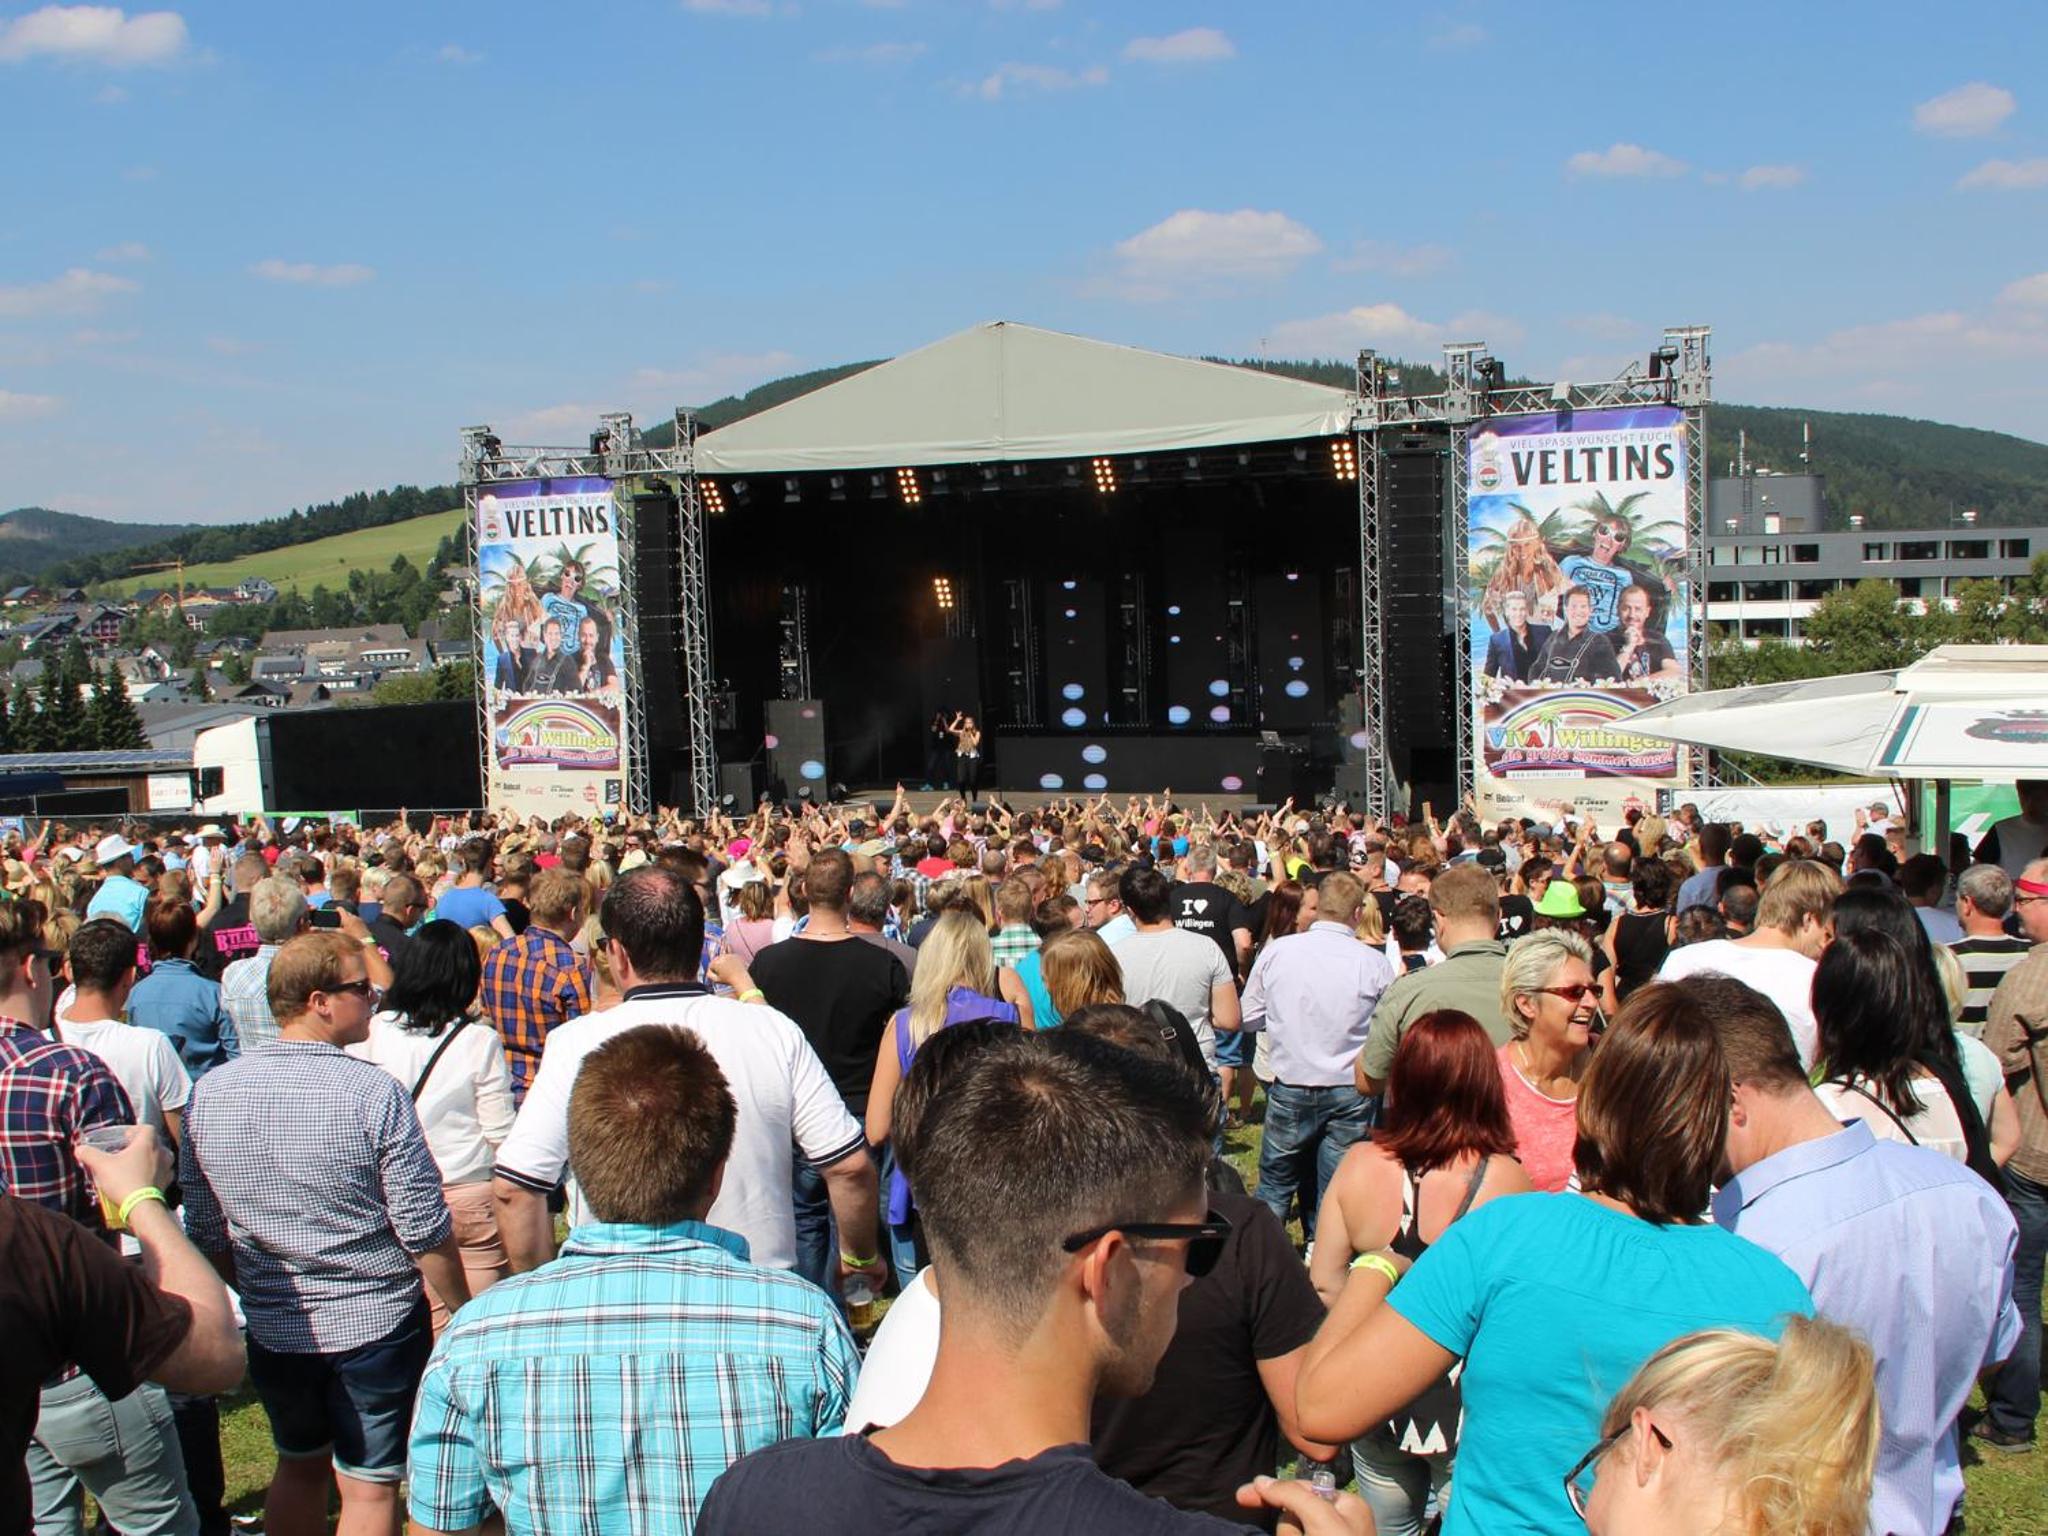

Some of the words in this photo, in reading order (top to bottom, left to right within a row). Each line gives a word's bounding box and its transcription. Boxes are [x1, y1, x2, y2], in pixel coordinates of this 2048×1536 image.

[1510, 438, 1534, 449] VIEL
[1538, 436, 1573, 448] SPASS
[1639, 431, 1672, 442] EUCH
[1510, 443, 1674, 486] VELTINS
[505, 505, 609, 538] VELTINS
[542, 731, 614, 751] Willingen
[1487, 727, 1543, 748] VIVA
[1182, 899, 1193, 915] I
[1175, 919, 1214, 930] Willingen
